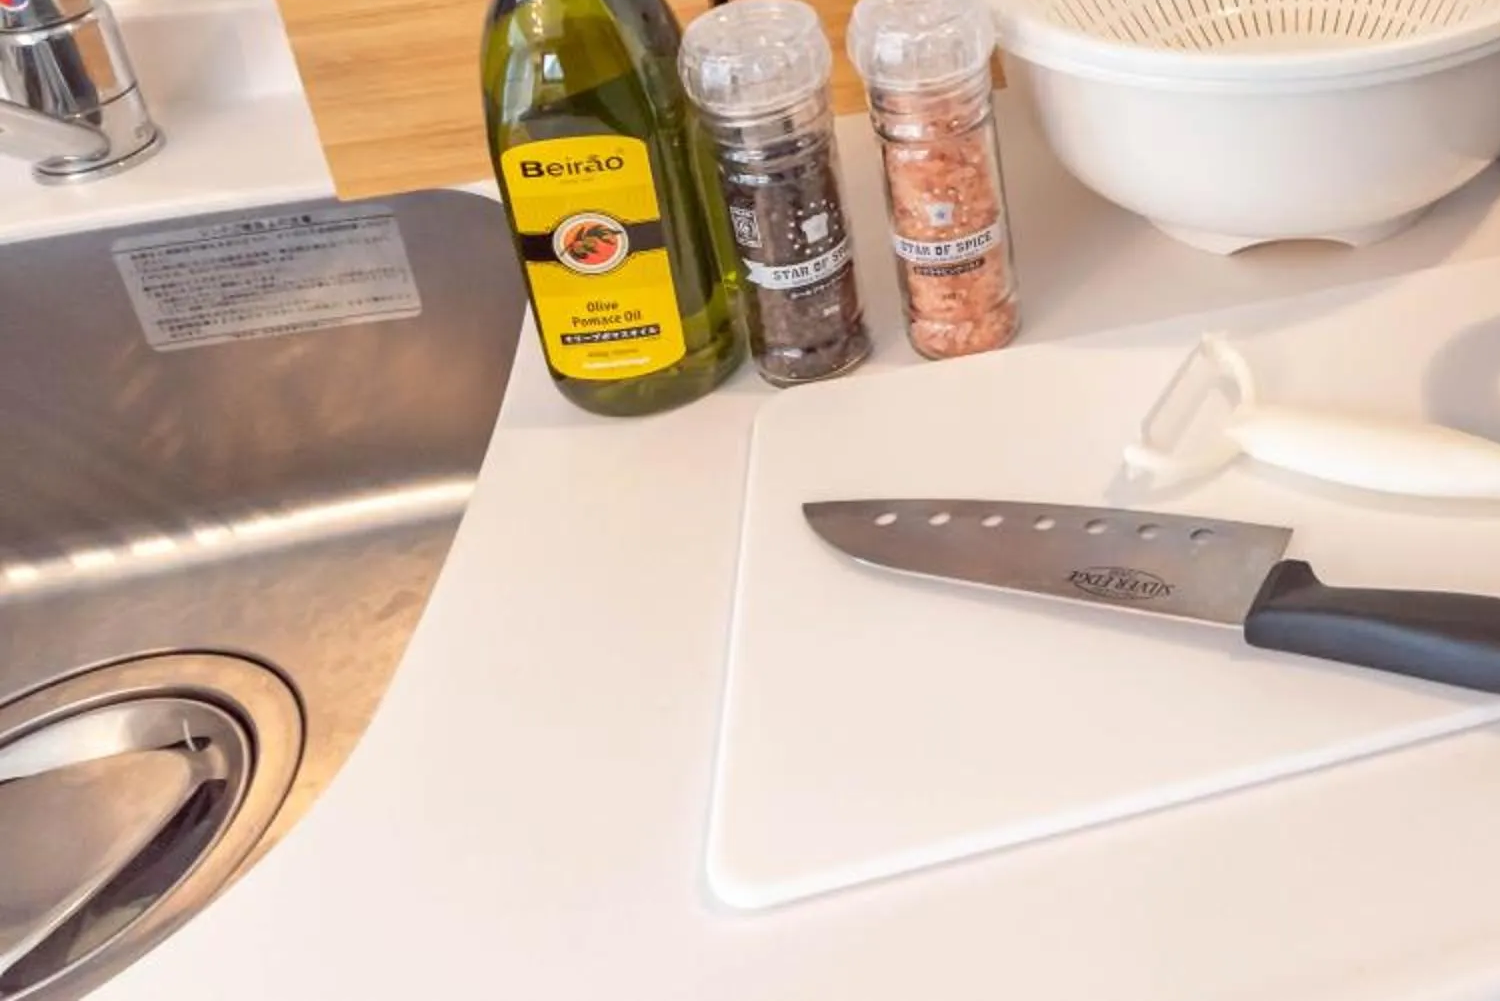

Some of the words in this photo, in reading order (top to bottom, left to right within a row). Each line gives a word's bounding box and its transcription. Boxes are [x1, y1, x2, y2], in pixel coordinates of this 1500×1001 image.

[520, 155, 624, 178] Beirão
[935, 244, 951, 256] OF
[955, 231, 992, 252] SPICE
[772, 265, 810, 281] STAR
[587, 301, 618, 312] Olive
[572, 315, 622, 327] Pomace
[623, 310, 641, 322] Oil
[1115, 577, 1177, 598] SILVER
